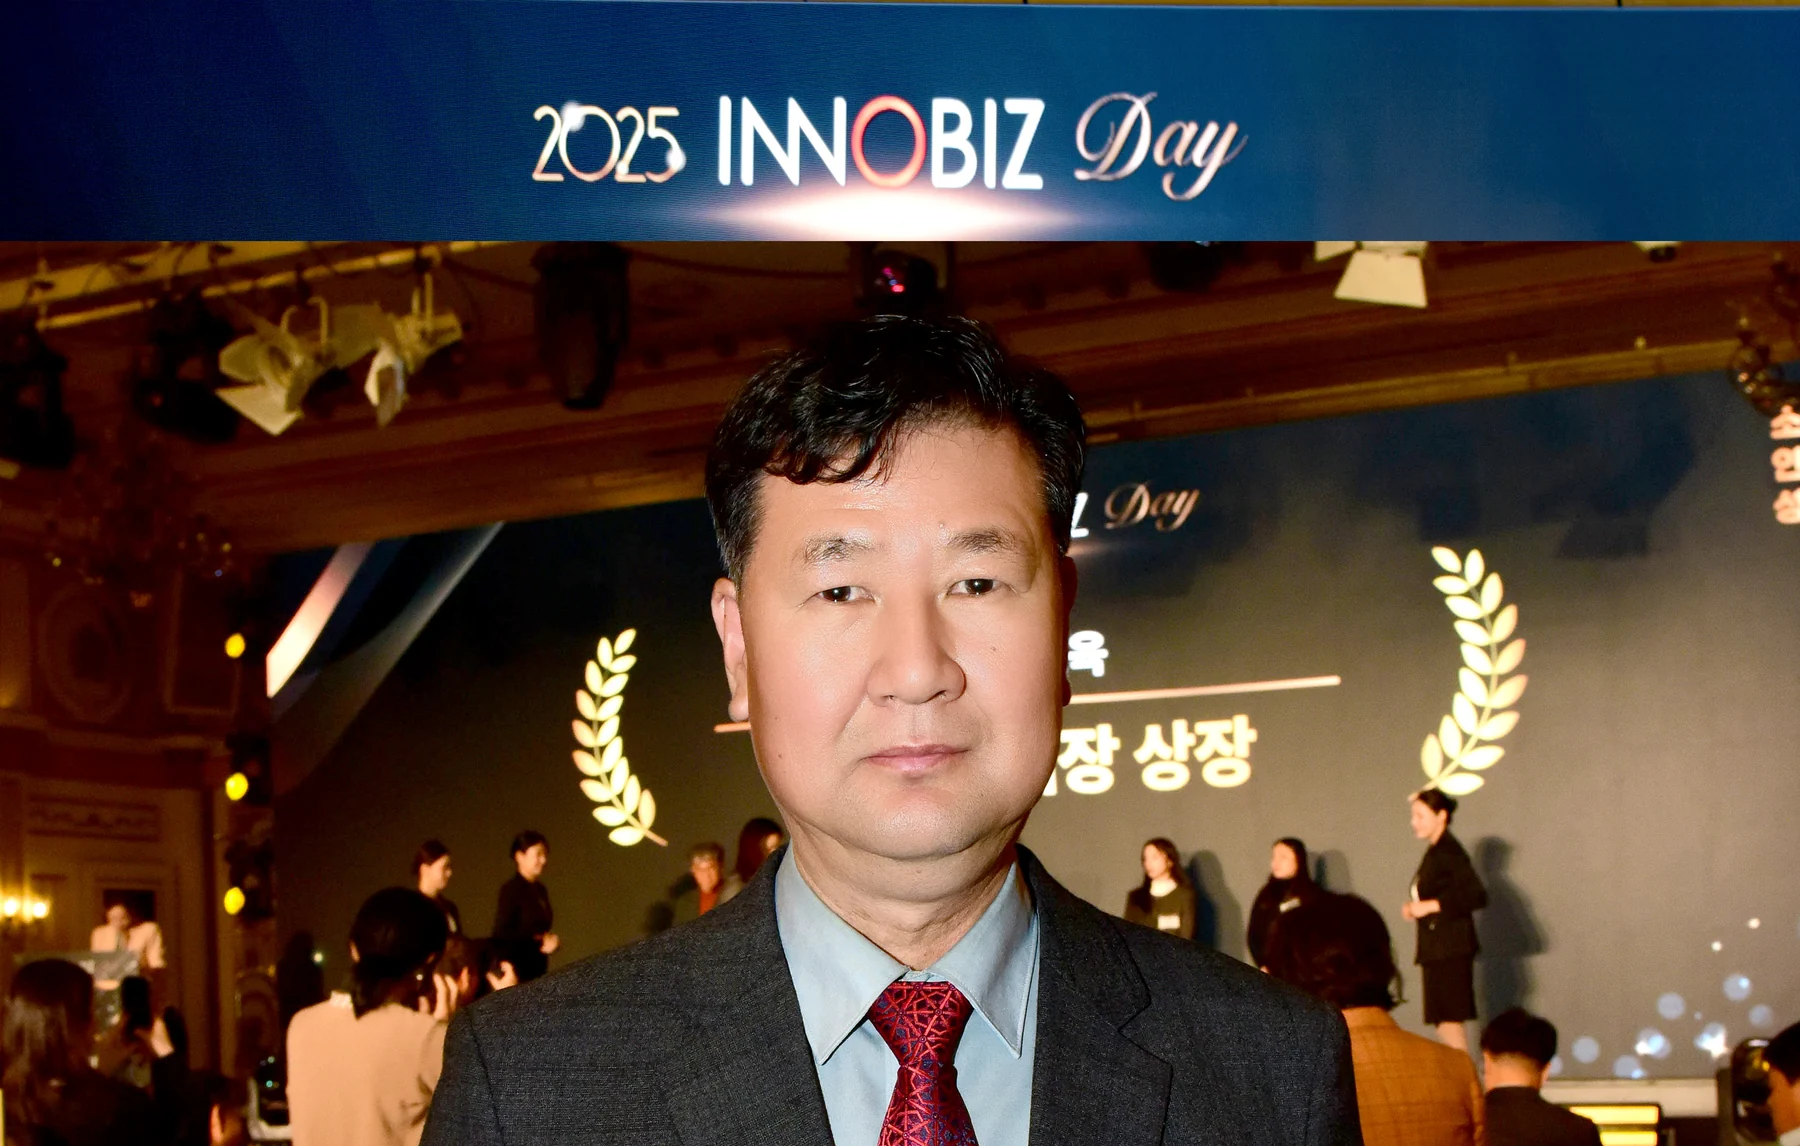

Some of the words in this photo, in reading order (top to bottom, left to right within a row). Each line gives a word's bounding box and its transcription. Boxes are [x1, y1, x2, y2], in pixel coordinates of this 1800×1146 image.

[531, 102, 687, 184] 2025
[717, 94, 1045, 191] INNOBIZ
[1074, 91, 1249, 201] Day
[1104, 480, 1200, 532] Day
[1133, 714, 1258, 791] 상장
